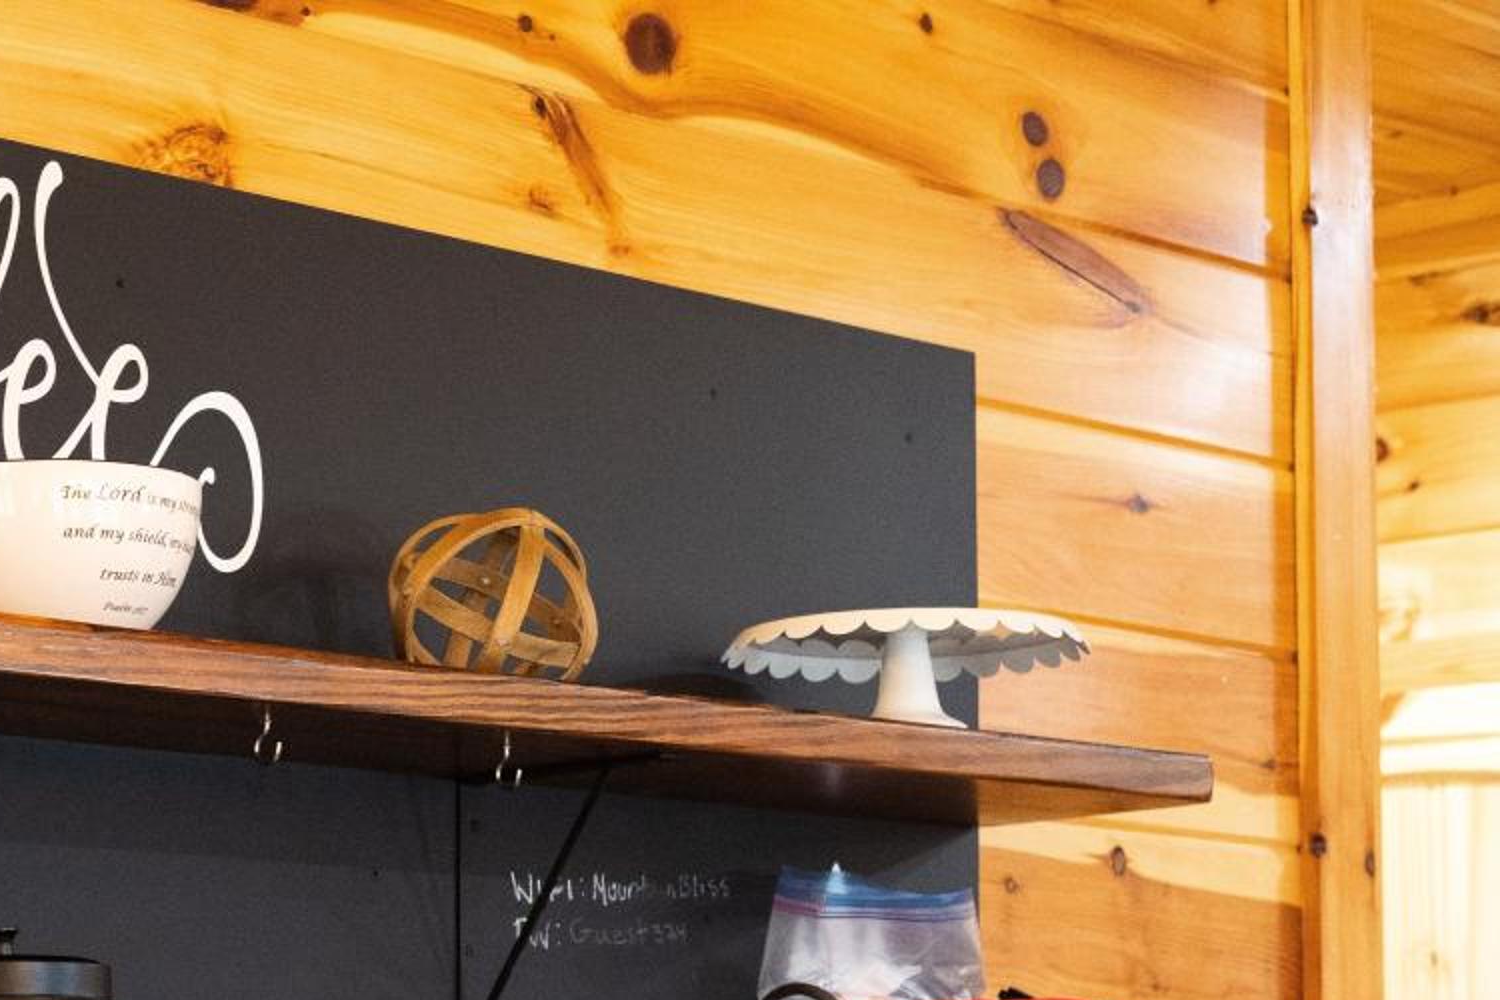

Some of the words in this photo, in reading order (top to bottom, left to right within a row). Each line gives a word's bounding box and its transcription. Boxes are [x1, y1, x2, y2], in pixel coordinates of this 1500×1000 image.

[97, 482, 148, 503] Lord
[63, 523, 97, 542] and
[100, 526, 125, 544] my
[99, 569, 140, 584] trusts
